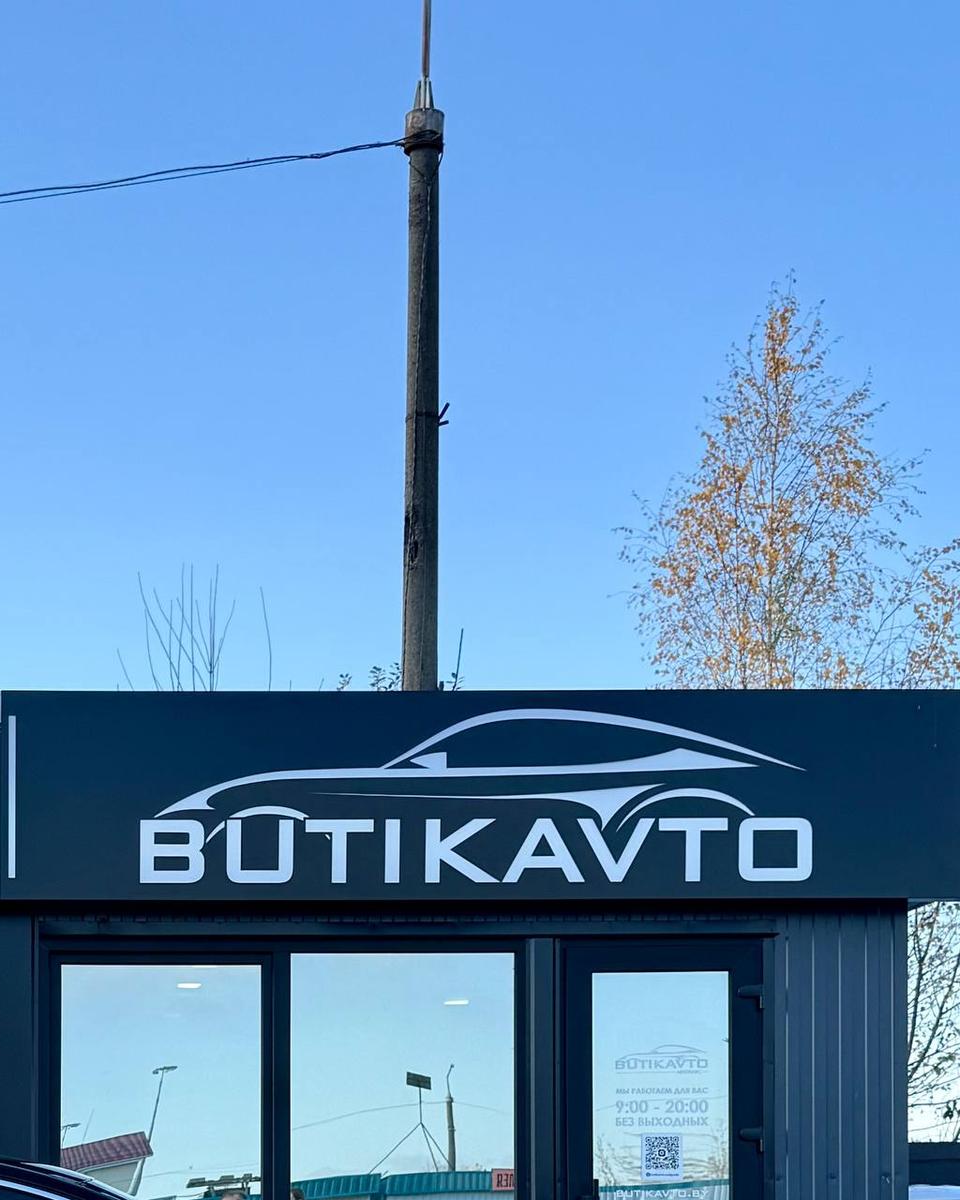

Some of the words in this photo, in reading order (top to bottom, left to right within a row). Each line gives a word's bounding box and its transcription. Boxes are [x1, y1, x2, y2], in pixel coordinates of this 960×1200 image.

[139, 816, 813, 884] BUTIKAVTO
[615, 1059, 708, 1070] BUTIKAVTO
[691, 1086, 709, 1094] ВАС
[615, 1100, 649, 1114] 9:00
[665, 1100, 709, 1114] 20:00
[615, 1117, 635, 1127] БЕЗ
[638, 1116, 709, 1127] ВЫХОДНЫХ
[616, 1189, 709, 1198] BUTIKAVTO.BY
